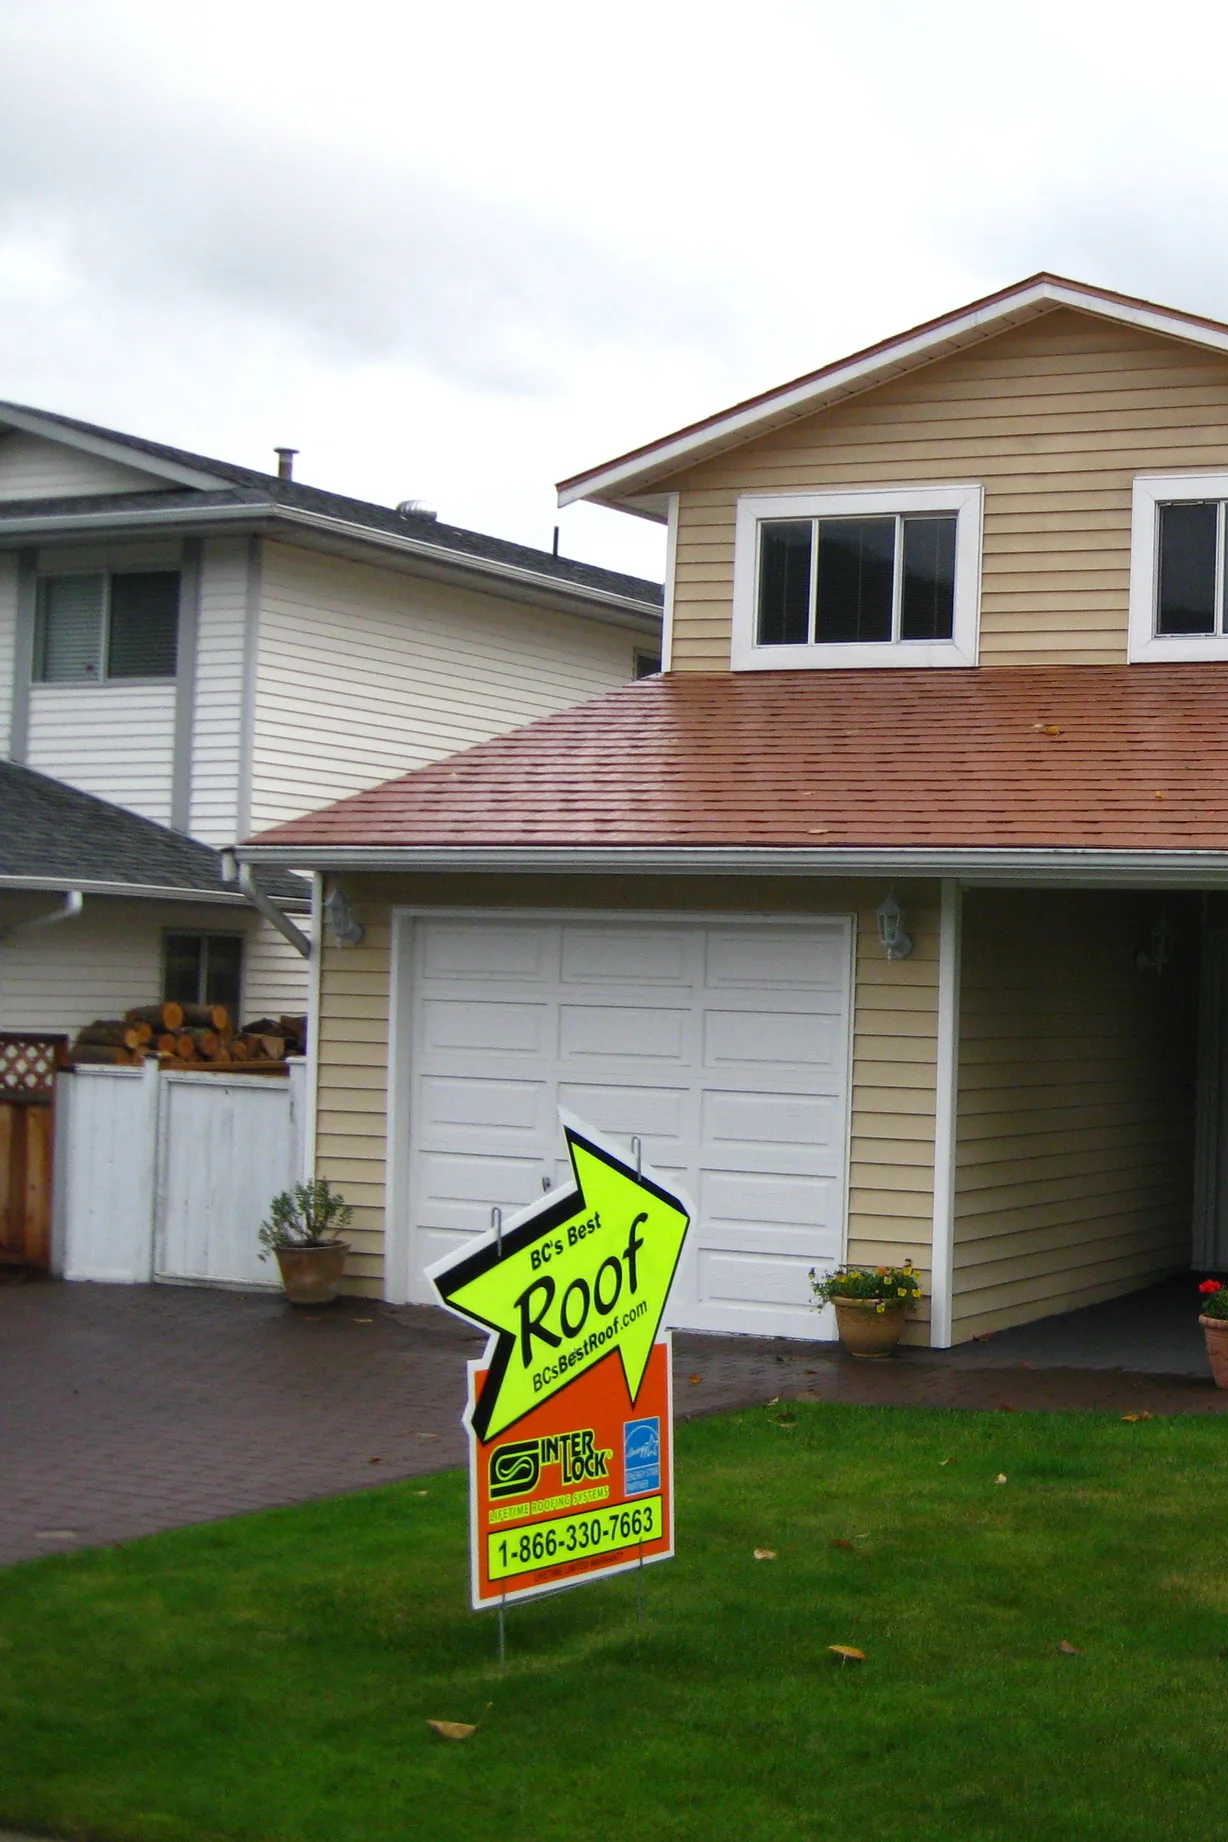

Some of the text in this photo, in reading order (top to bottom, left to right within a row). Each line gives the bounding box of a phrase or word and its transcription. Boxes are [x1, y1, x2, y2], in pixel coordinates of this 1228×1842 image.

[530, 1211, 602, 1271] BC's Best
[532, 1300, 648, 1393] BCsBestRoof.com
[541, 1430, 594, 1464] INTER
[489, 1487, 609, 1522] LIFETIME ROOFING SYSTEMS
[498, 1507, 654, 1567] 1-866-330-7663
